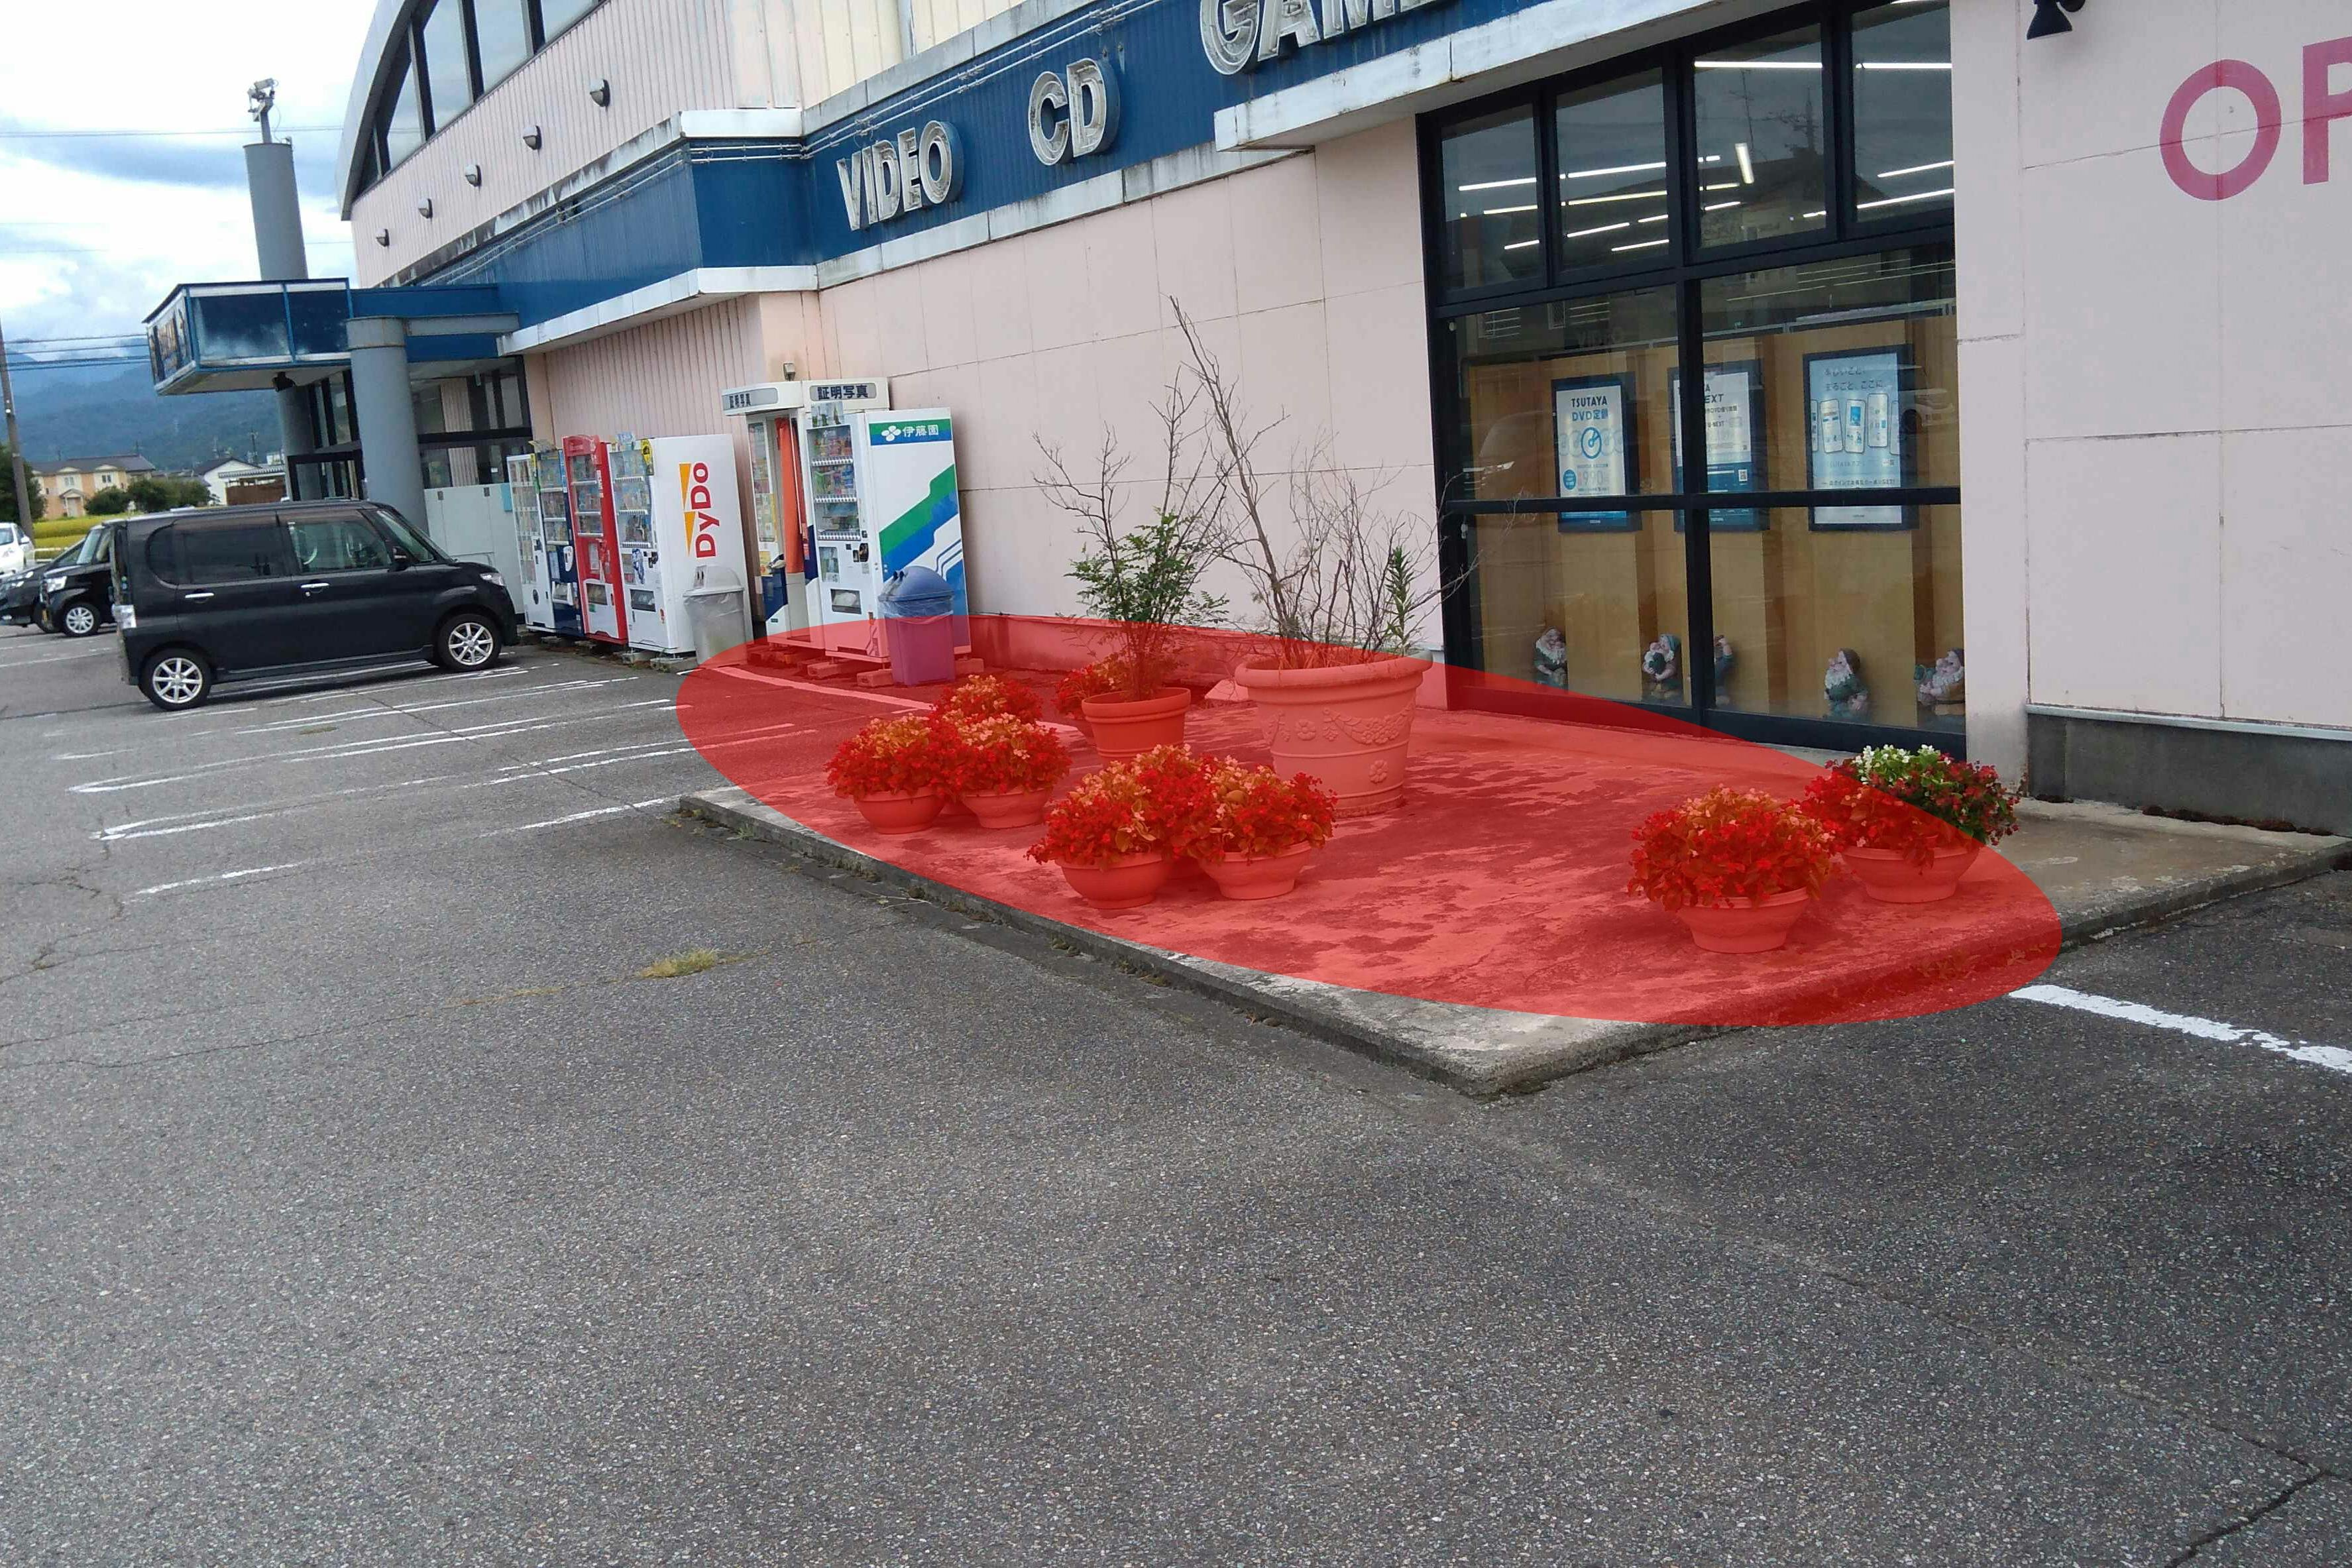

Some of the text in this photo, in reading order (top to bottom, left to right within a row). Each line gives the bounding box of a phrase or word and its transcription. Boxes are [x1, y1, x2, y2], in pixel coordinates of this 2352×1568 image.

[836, 0, 1443, 231] VIDEO CD GA
[818, 384, 869, 400] 証明写真
[1705, 394, 1724, 403] EXT
[729, 393, 751, 408] 証明写真
[1571, 396, 1607, 408] TSUTAYA
[903, 425, 938, 437] 伊藤園
